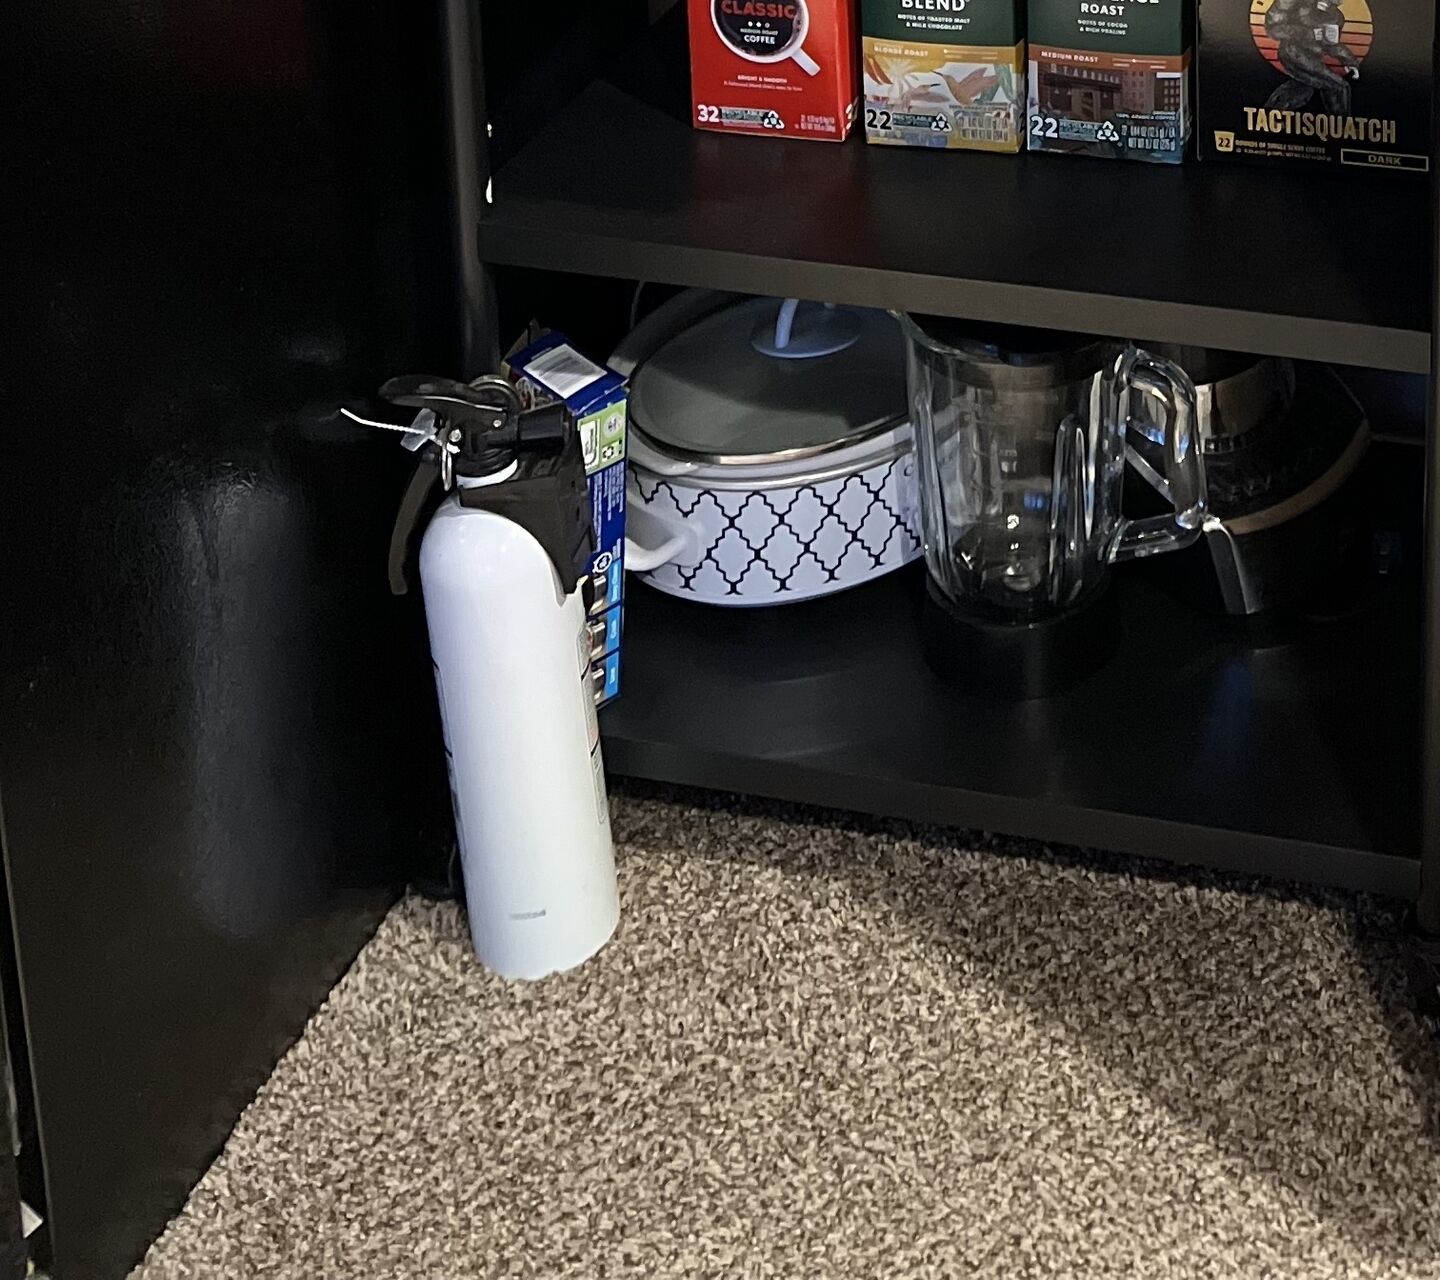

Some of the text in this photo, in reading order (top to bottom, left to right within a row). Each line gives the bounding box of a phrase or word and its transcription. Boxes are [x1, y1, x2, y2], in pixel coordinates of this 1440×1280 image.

[721, 0, 797, 19] CLASSIC
[1080, 3, 1125, 16] ROAST
[744, 34, 775, 45] COFFEE
[904, 48, 928, 56] ROAST
[1041, 51, 1098, 62] MEDIUM ROAST
[697, 104, 719, 122] 32
[866, 108, 892, 130] 22
[1030, 116, 1058, 138] 22
[1243, 107, 1396, 144] TACTISQUATCH
[1218, 137, 1230, 148] 22
[1305, 146, 1326, 154] COFFEE
[1368, 154, 1401, 166] DARK
